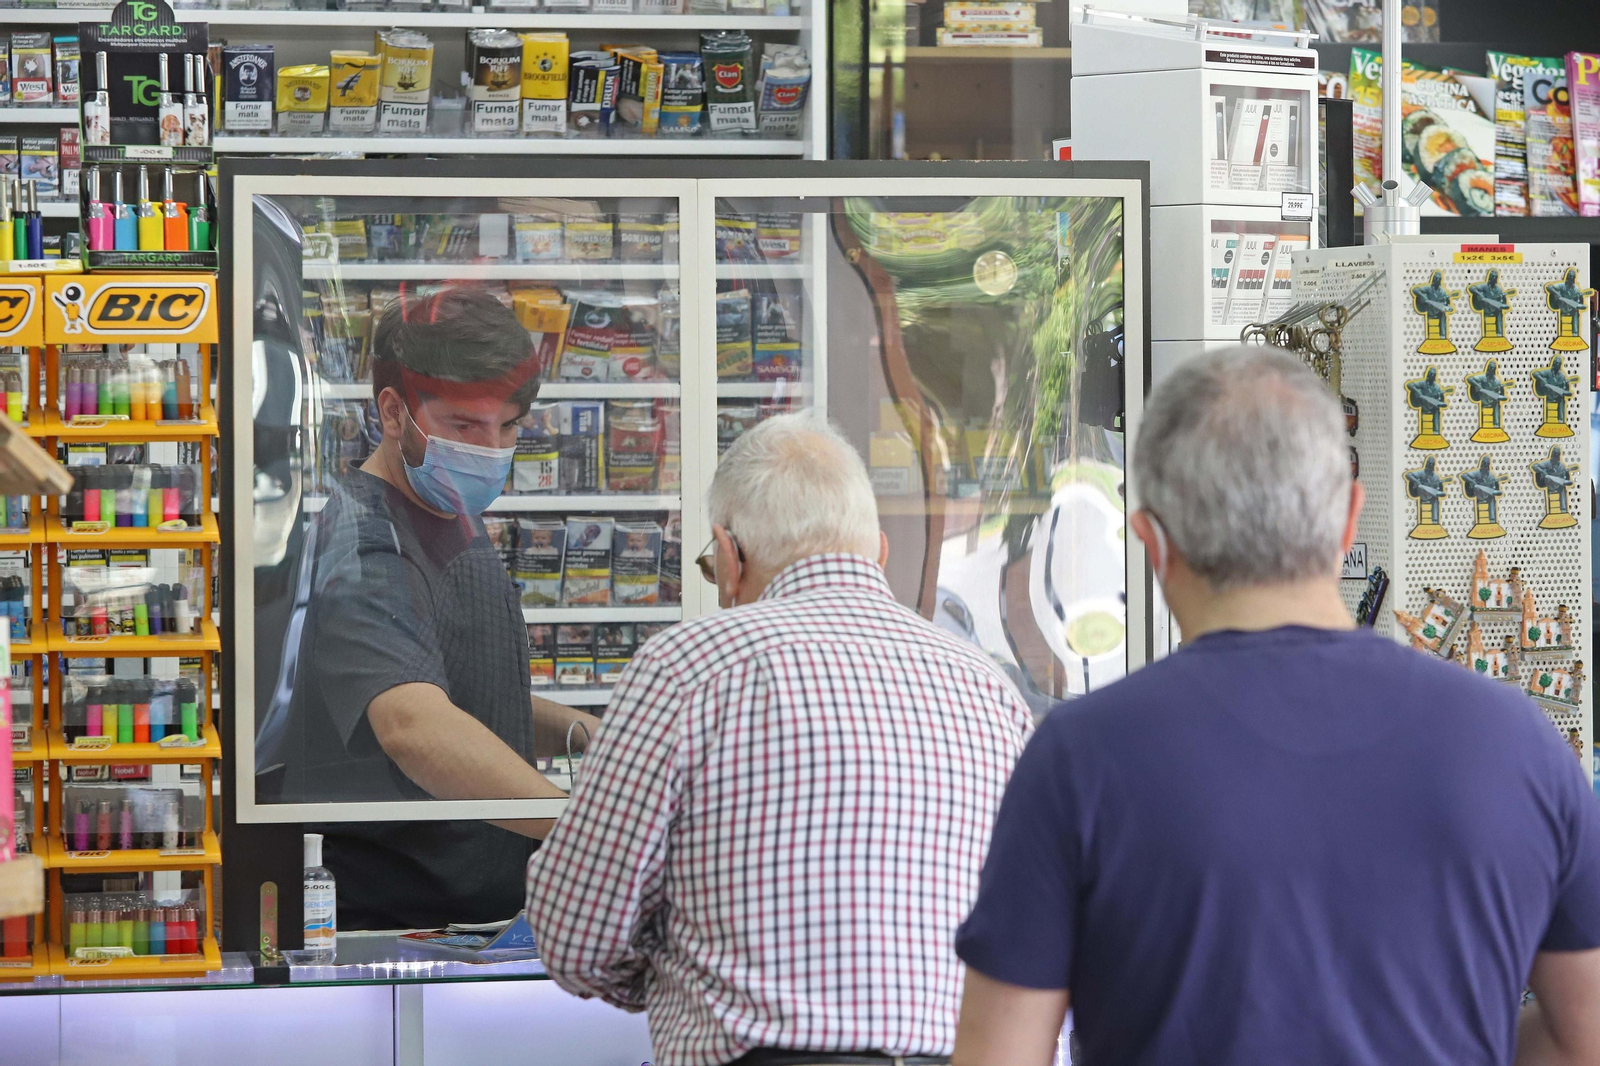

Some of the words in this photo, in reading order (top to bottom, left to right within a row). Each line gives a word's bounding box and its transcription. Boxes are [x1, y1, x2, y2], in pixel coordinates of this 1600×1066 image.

[127, 1, 158, 22] TG
[99, 24, 183, 36] TARGARD
[387, 56, 429, 67] BORKUM
[479, 56, 521, 65] BORKUM
[489, 64, 510, 73] RIFF
[523, 72, 567, 82] BROOKFIELD
[20, 83, 46, 91] West
[124, 76, 160, 107] TG
[602, 75, 615, 108] DRUM
[1416, 80, 1469, 96] COCINA
[382, 104, 427, 117] Fumar
[476, 104, 520, 113] Fumar
[528, 102, 562, 111] Fumar
[710, 104, 752, 115] Fumar
[481, 117, 514, 126] mata
[531, 114, 558, 122] mata
[716, 117, 750, 125] mata
[387, 118, 420, 129] mata
[764, 124, 796, 132] mata
[760, 240, 787, 249] West
[124, 253, 182, 262] TARGARD
